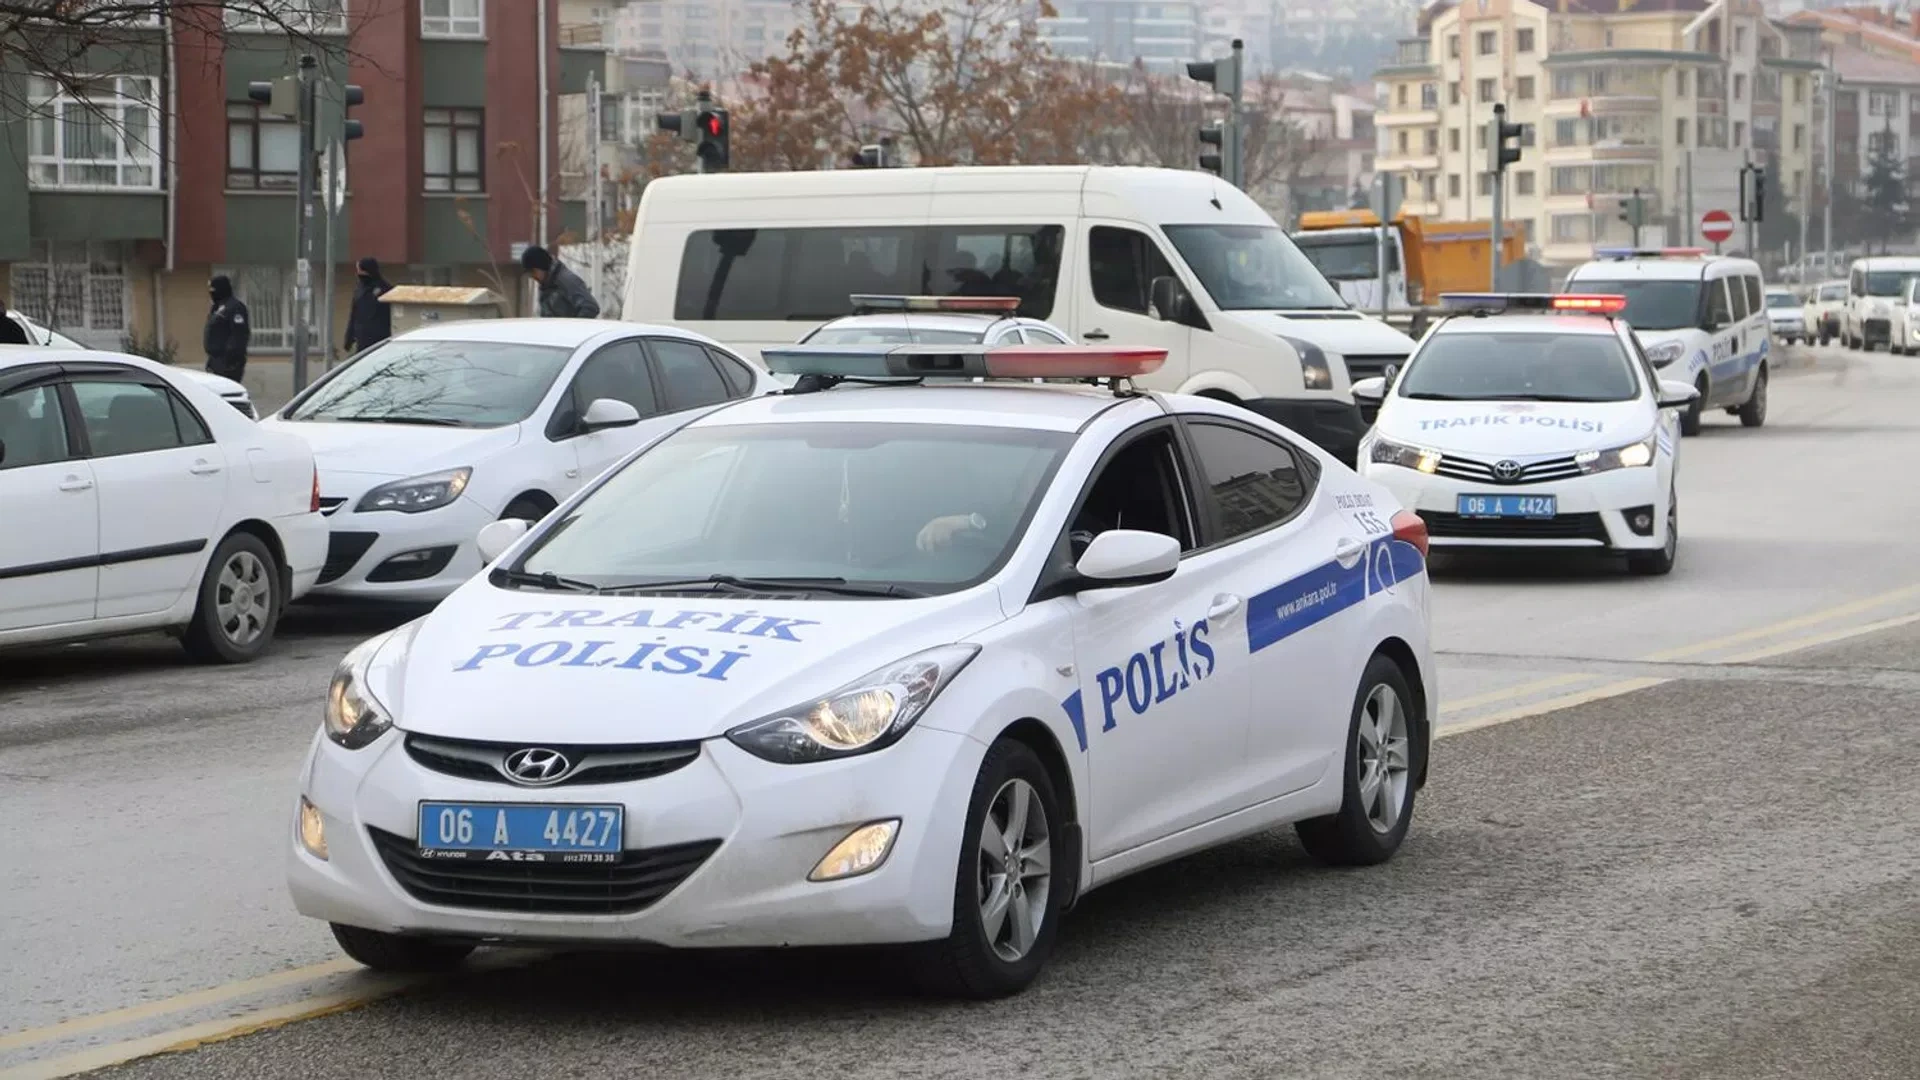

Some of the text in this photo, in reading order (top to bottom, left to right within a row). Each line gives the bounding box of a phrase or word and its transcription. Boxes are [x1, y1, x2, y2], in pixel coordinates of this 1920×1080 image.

[1419, 415, 1604, 433] TRAFİK POLİSİ
[1353, 511, 1388, 534] 155
[1468, 498, 1552, 514] 06 A 4424
[489, 609, 821, 643] TRAFİK
[451, 635, 752, 681] POLİSİ
[1096, 617, 1215, 733] POLİS
[439, 808, 616, 847] 06 A 4427
